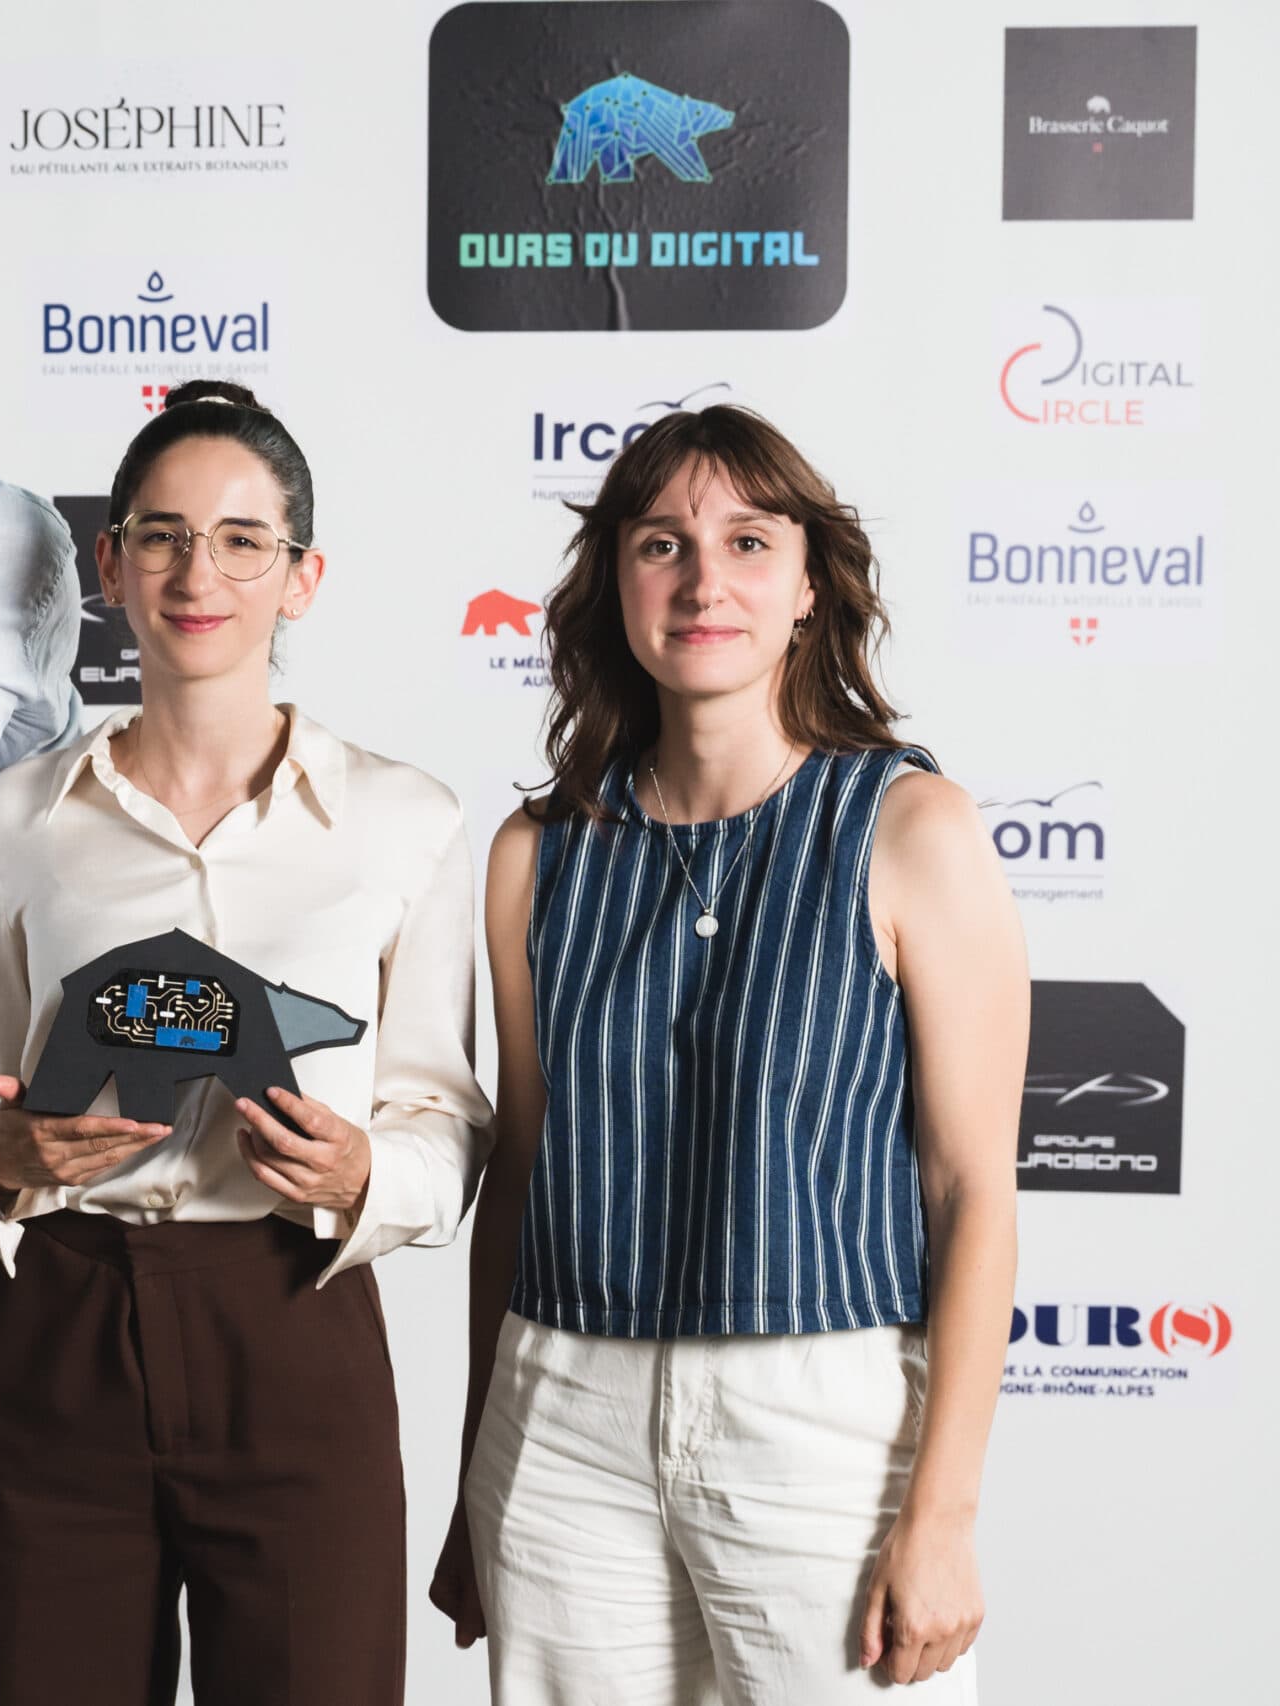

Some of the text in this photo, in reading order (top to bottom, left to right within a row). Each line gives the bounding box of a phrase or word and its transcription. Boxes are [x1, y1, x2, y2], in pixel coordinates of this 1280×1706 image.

[10, 96, 286, 151] JOSÉPHINE
[1029, 116, 1168, 137] Brasserie Caquot
[10, 159, 288, 175] EAU PÉTILLANTE AUX EXTRAITS BOTANIQUES
[459, 231, 819, 268] OURS DU DIGITAL
[43, 302, 269, 354] Bonneval
[969, 532, 1204, 586] Bonneval
[490, 655, 550, 669] LE MÉD
[1033, 1135, 1115, 1148] GROUPE
[1023, 1366, 1042, 1377] LA
[1051, 1366, 1188, 1379] COMMUNICATION
